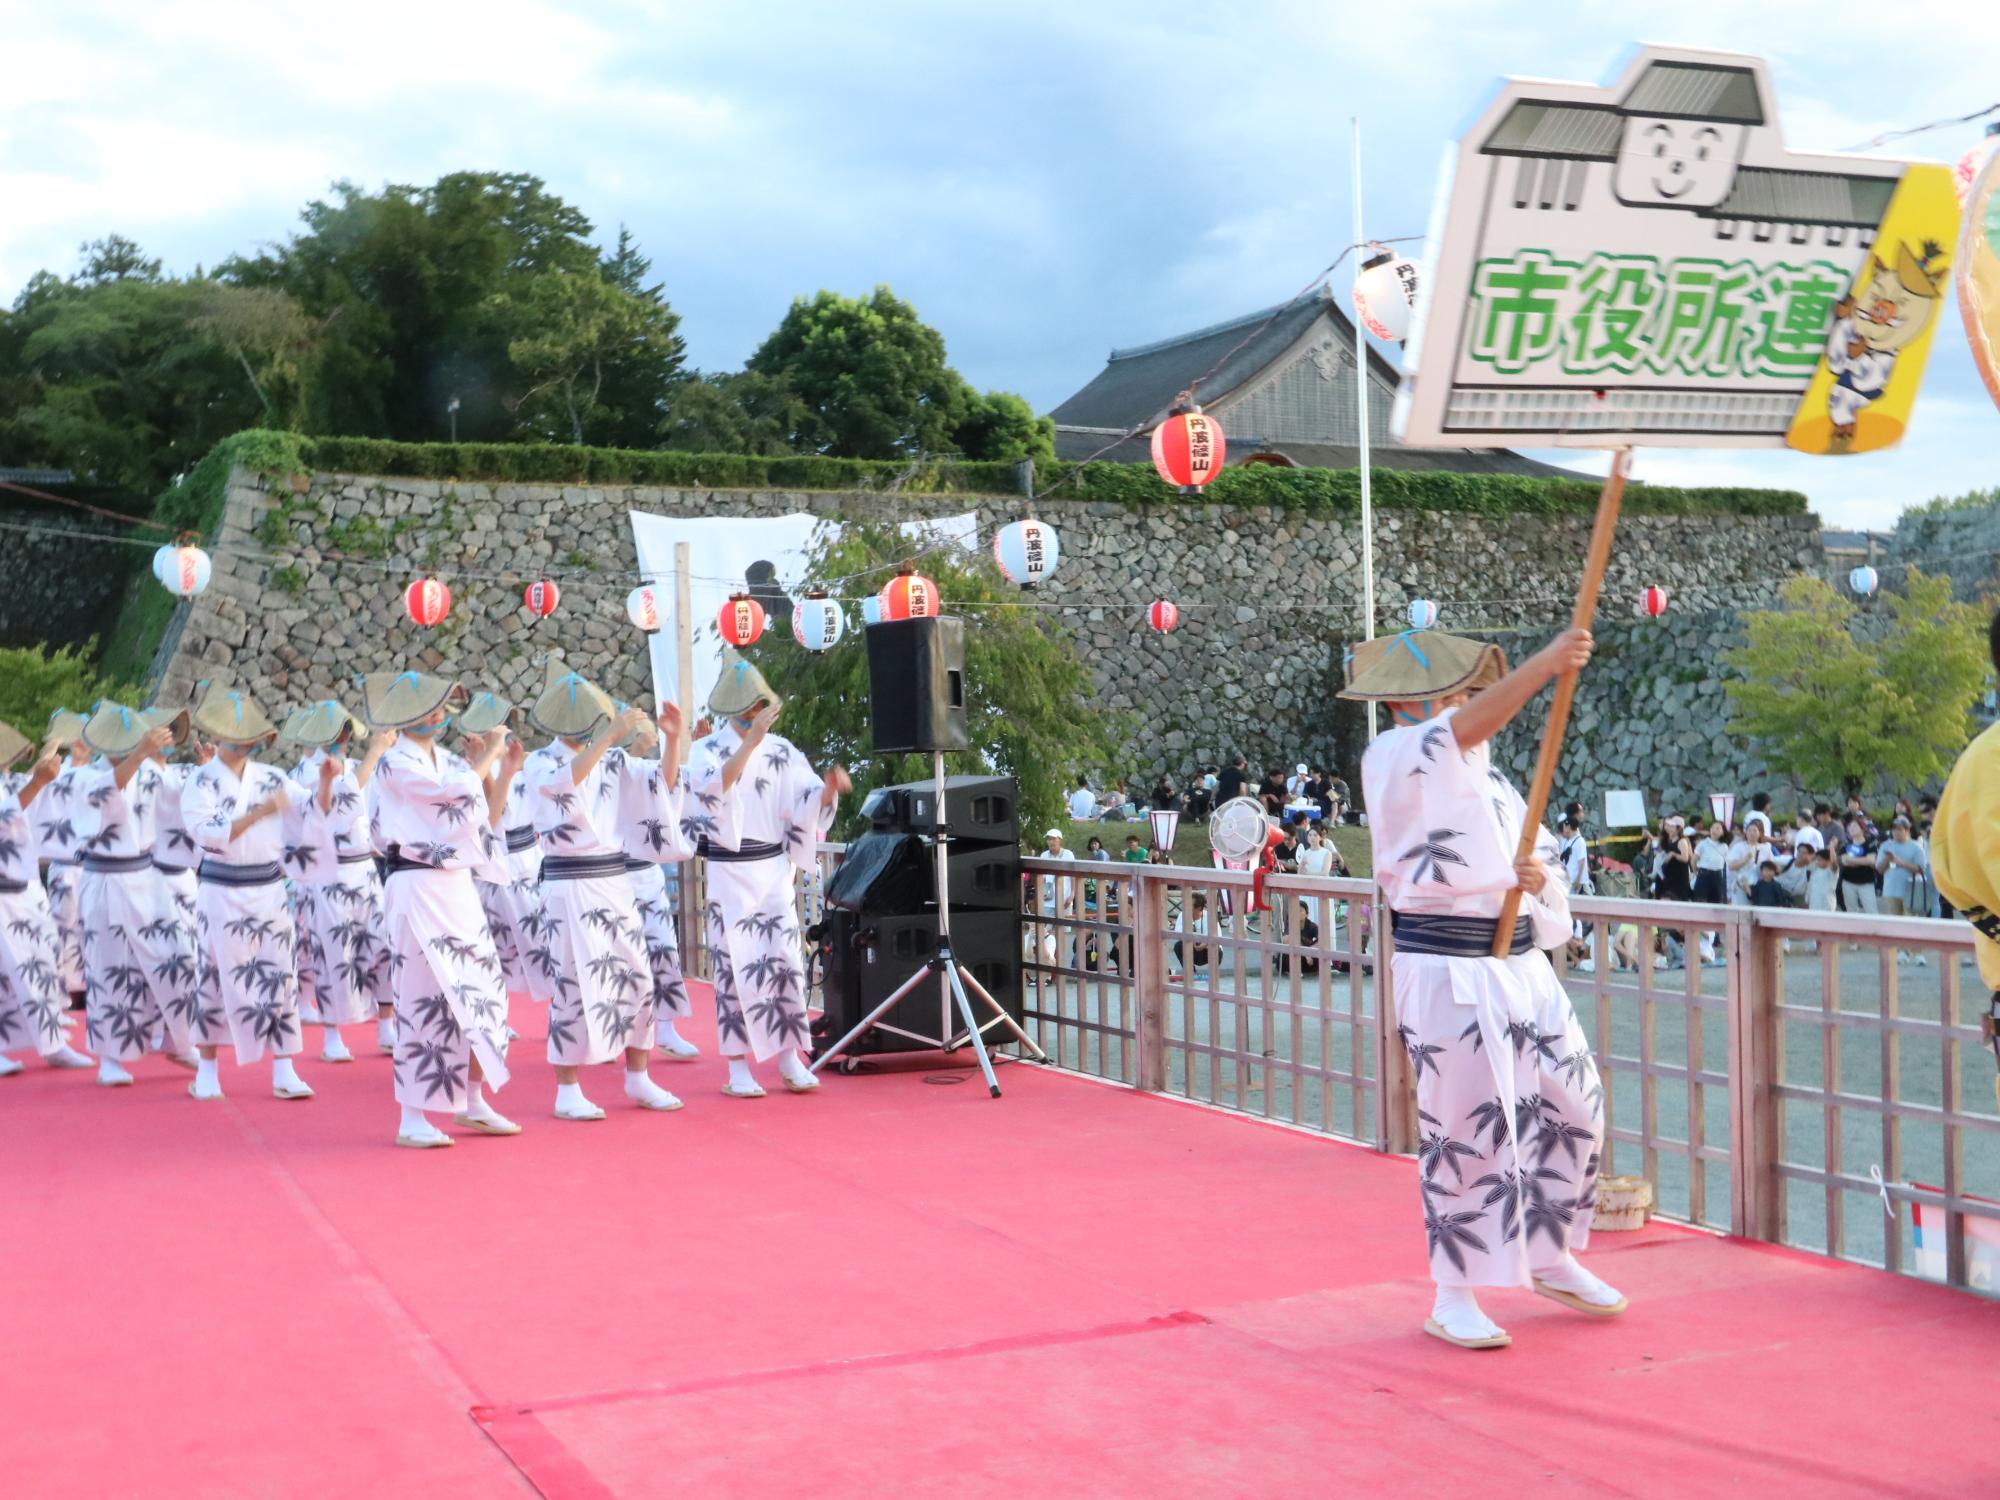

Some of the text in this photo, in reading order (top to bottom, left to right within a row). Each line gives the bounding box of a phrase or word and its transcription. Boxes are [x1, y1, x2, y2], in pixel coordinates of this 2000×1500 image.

[1470, 248, 1851, 378] 市役所連
[1190, 419, 1209, 471] 丹波篠山
[1025, 528, 1043, 573] 丹波篠山
[824, 607, 837, 643] 丹波篠山
